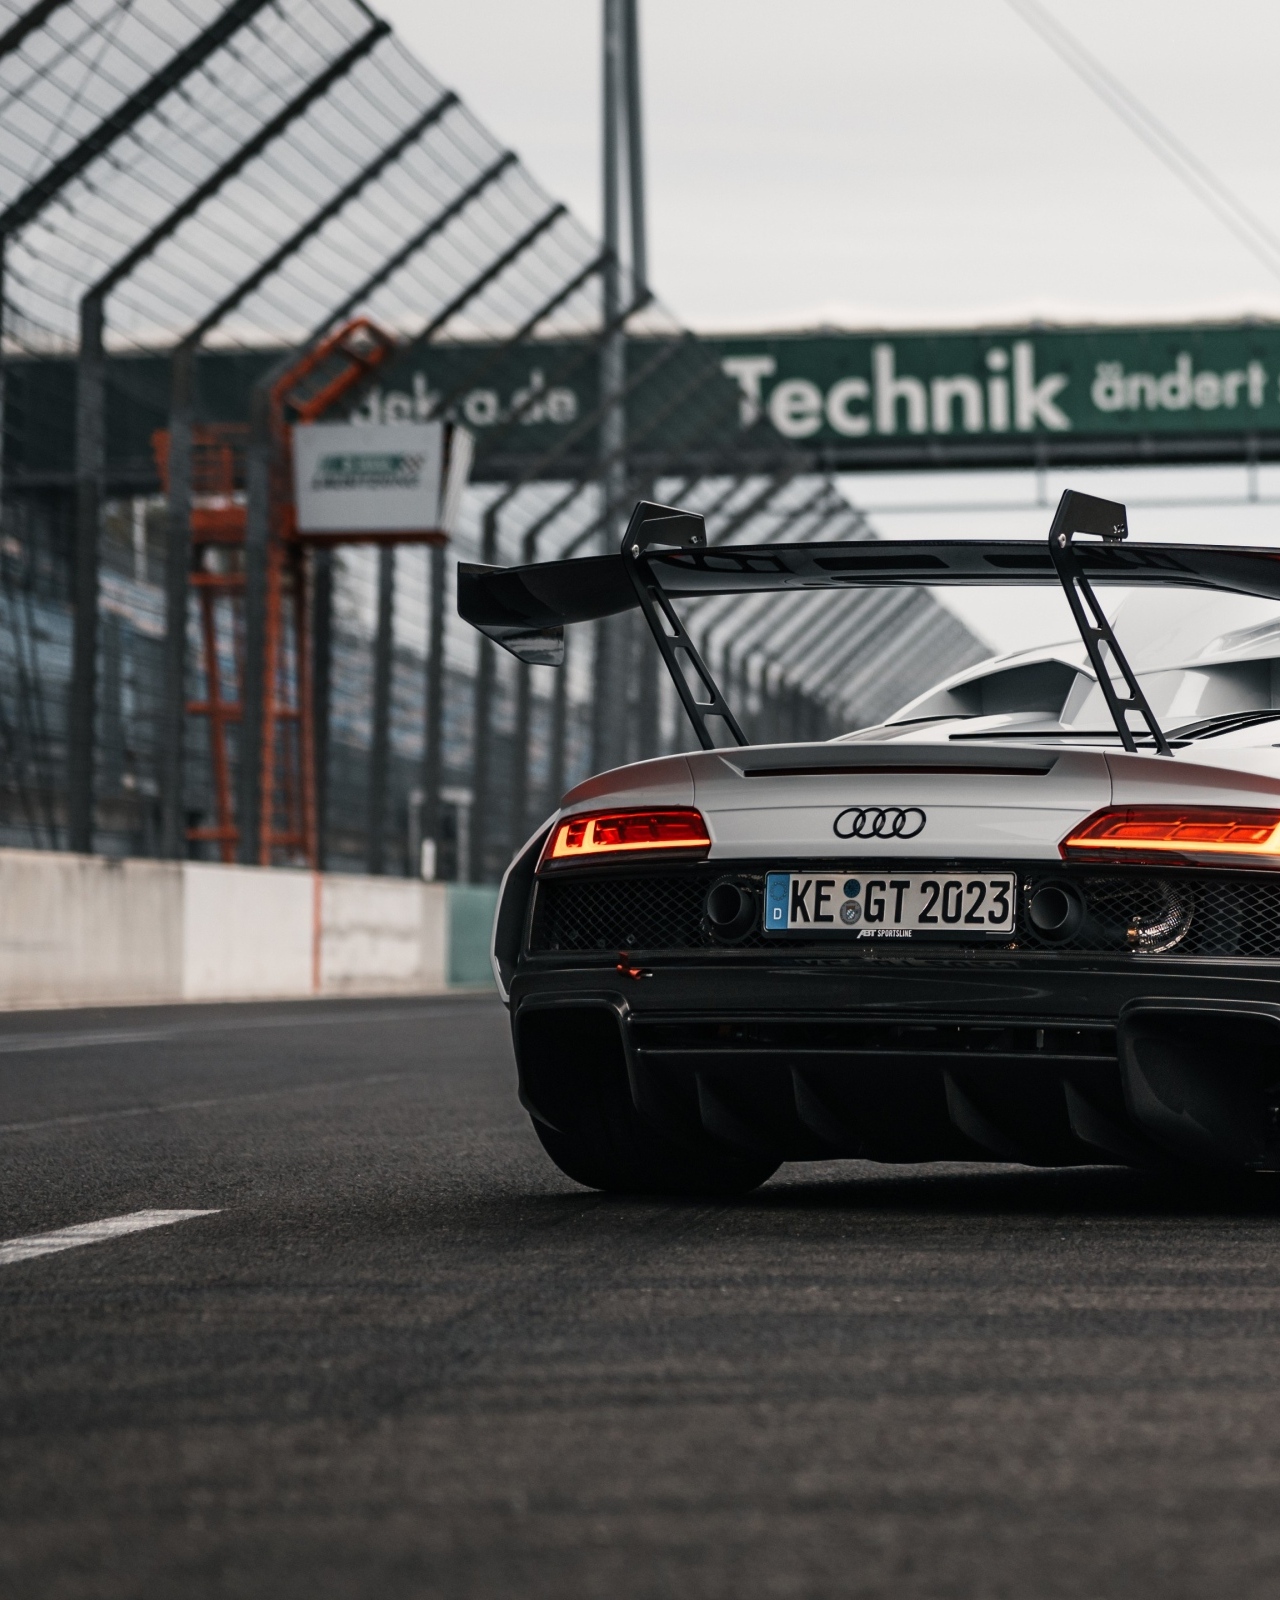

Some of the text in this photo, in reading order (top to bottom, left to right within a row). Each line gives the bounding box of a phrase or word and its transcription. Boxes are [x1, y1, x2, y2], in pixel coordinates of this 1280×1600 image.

[721, 341, 1072, 438] Technik
[1092, 351, 1265, 411] ändert
[773, 907, 782, 920] D
[790, 880, 1011, 924] KE GT 2023
[856, 929, 913, 939] ABT SPORTSLINE
